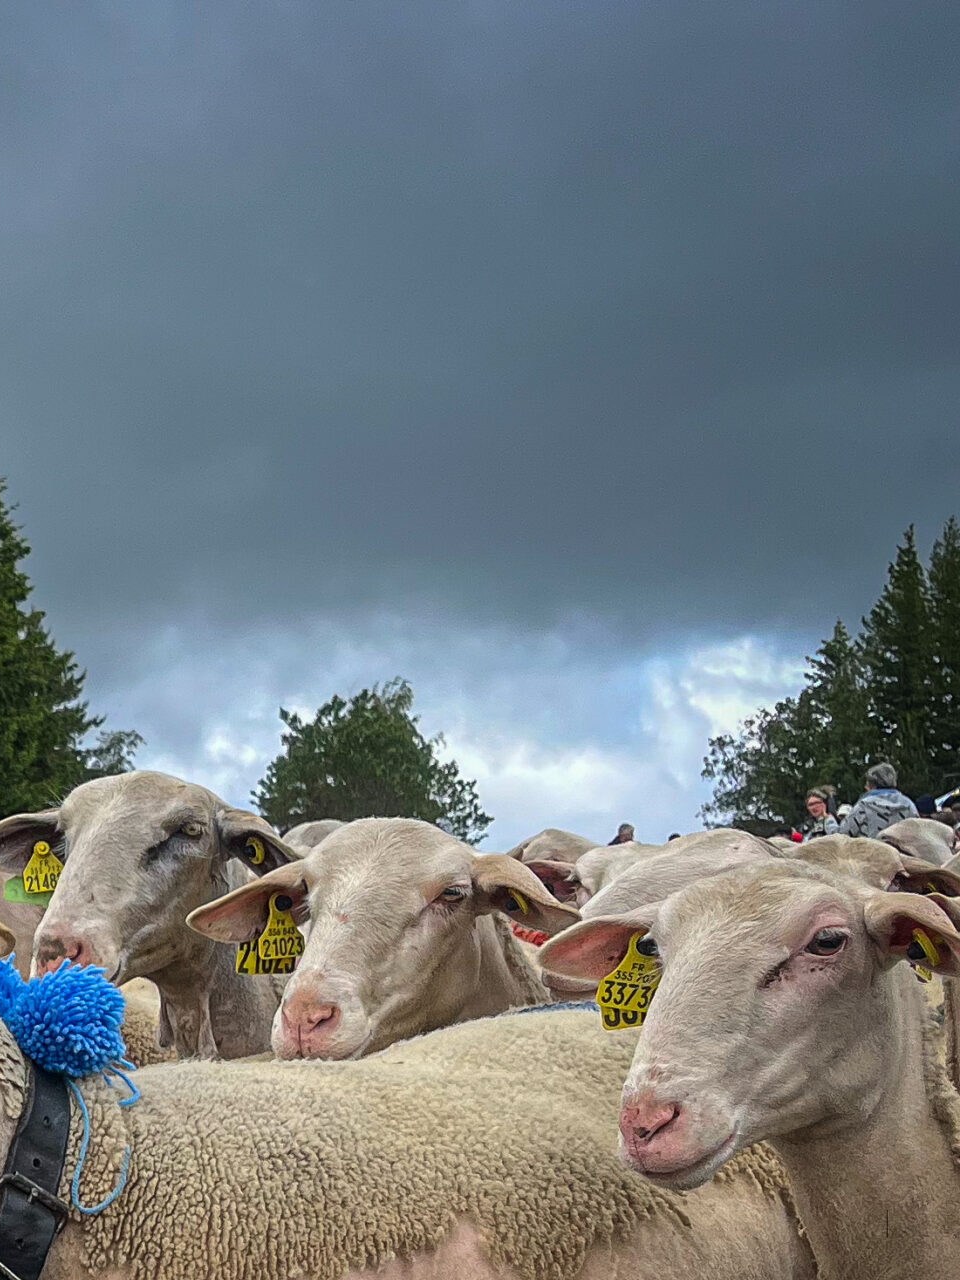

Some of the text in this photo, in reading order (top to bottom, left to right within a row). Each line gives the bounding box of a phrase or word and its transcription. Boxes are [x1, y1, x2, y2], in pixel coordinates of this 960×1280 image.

[262, 937, 302, 957] 21023
[631, 963, 645, 971] FR
[614, 971, 633, 981] 355
[601, 981, 656, 1008] 3373
